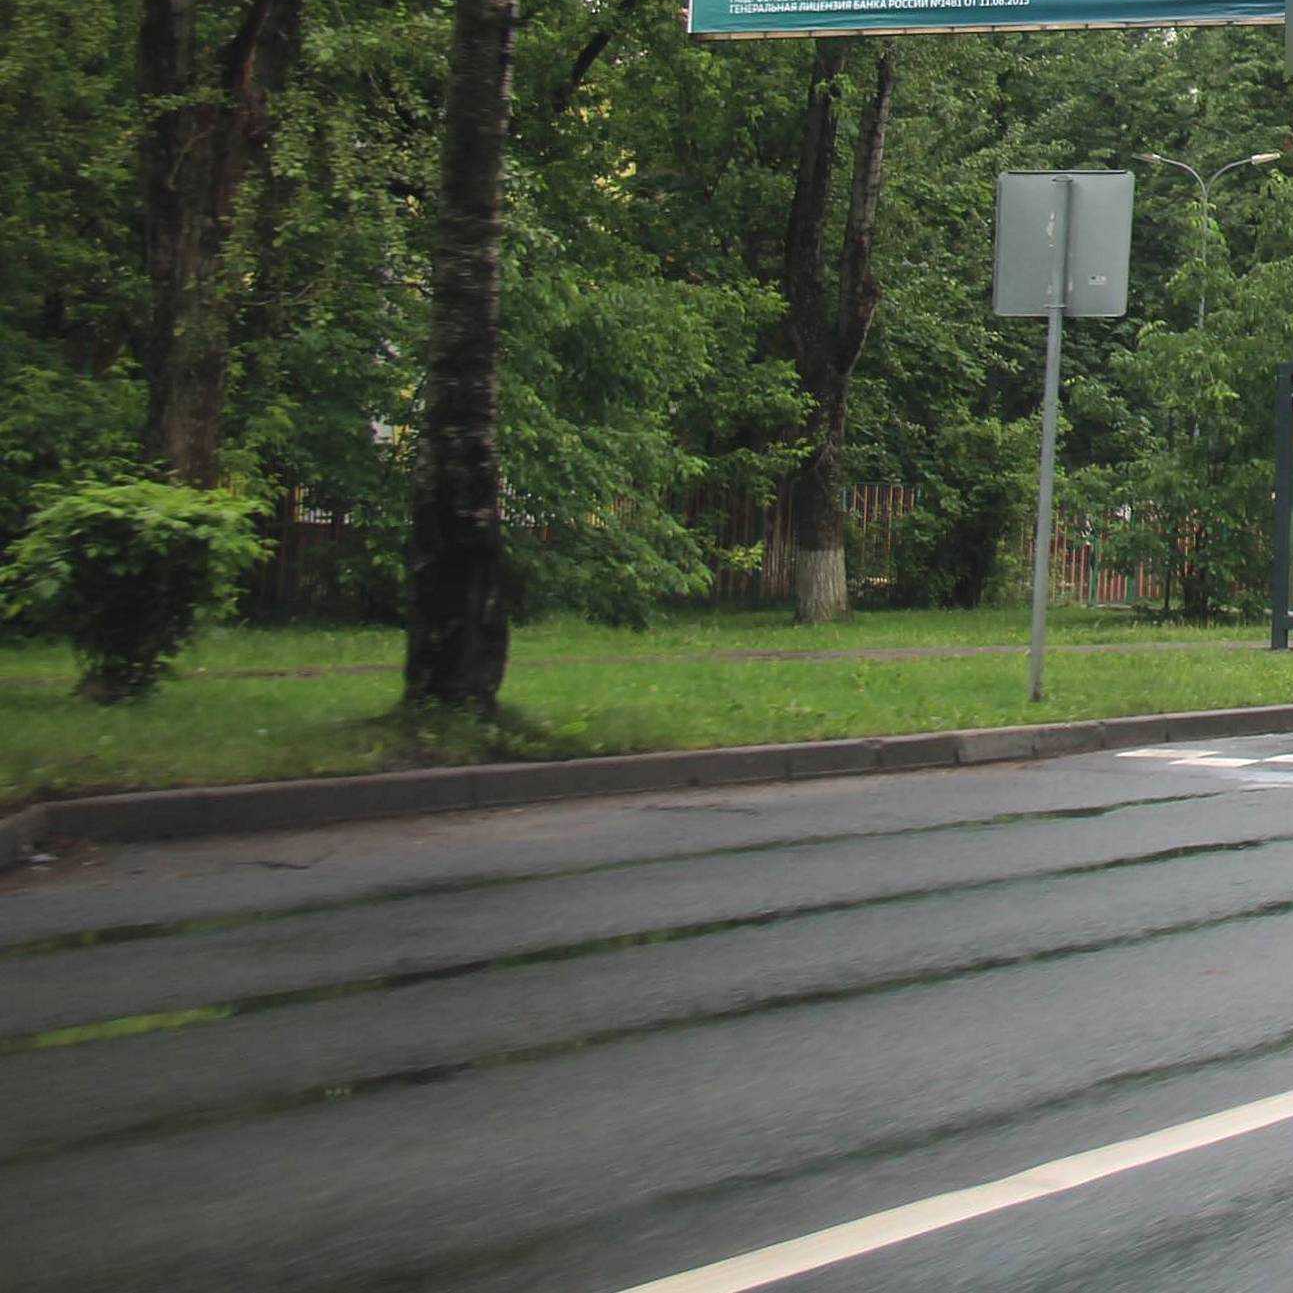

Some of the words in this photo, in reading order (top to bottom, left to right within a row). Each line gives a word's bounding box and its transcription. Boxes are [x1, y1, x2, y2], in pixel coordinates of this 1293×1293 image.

[730, 1, 798, 14] ГЕНЕРАЛЬНАЯ
[799, 0, 853, 12] ЛИЦЕНЗИЯ
[854, 0, 886, 10] БАНКА
